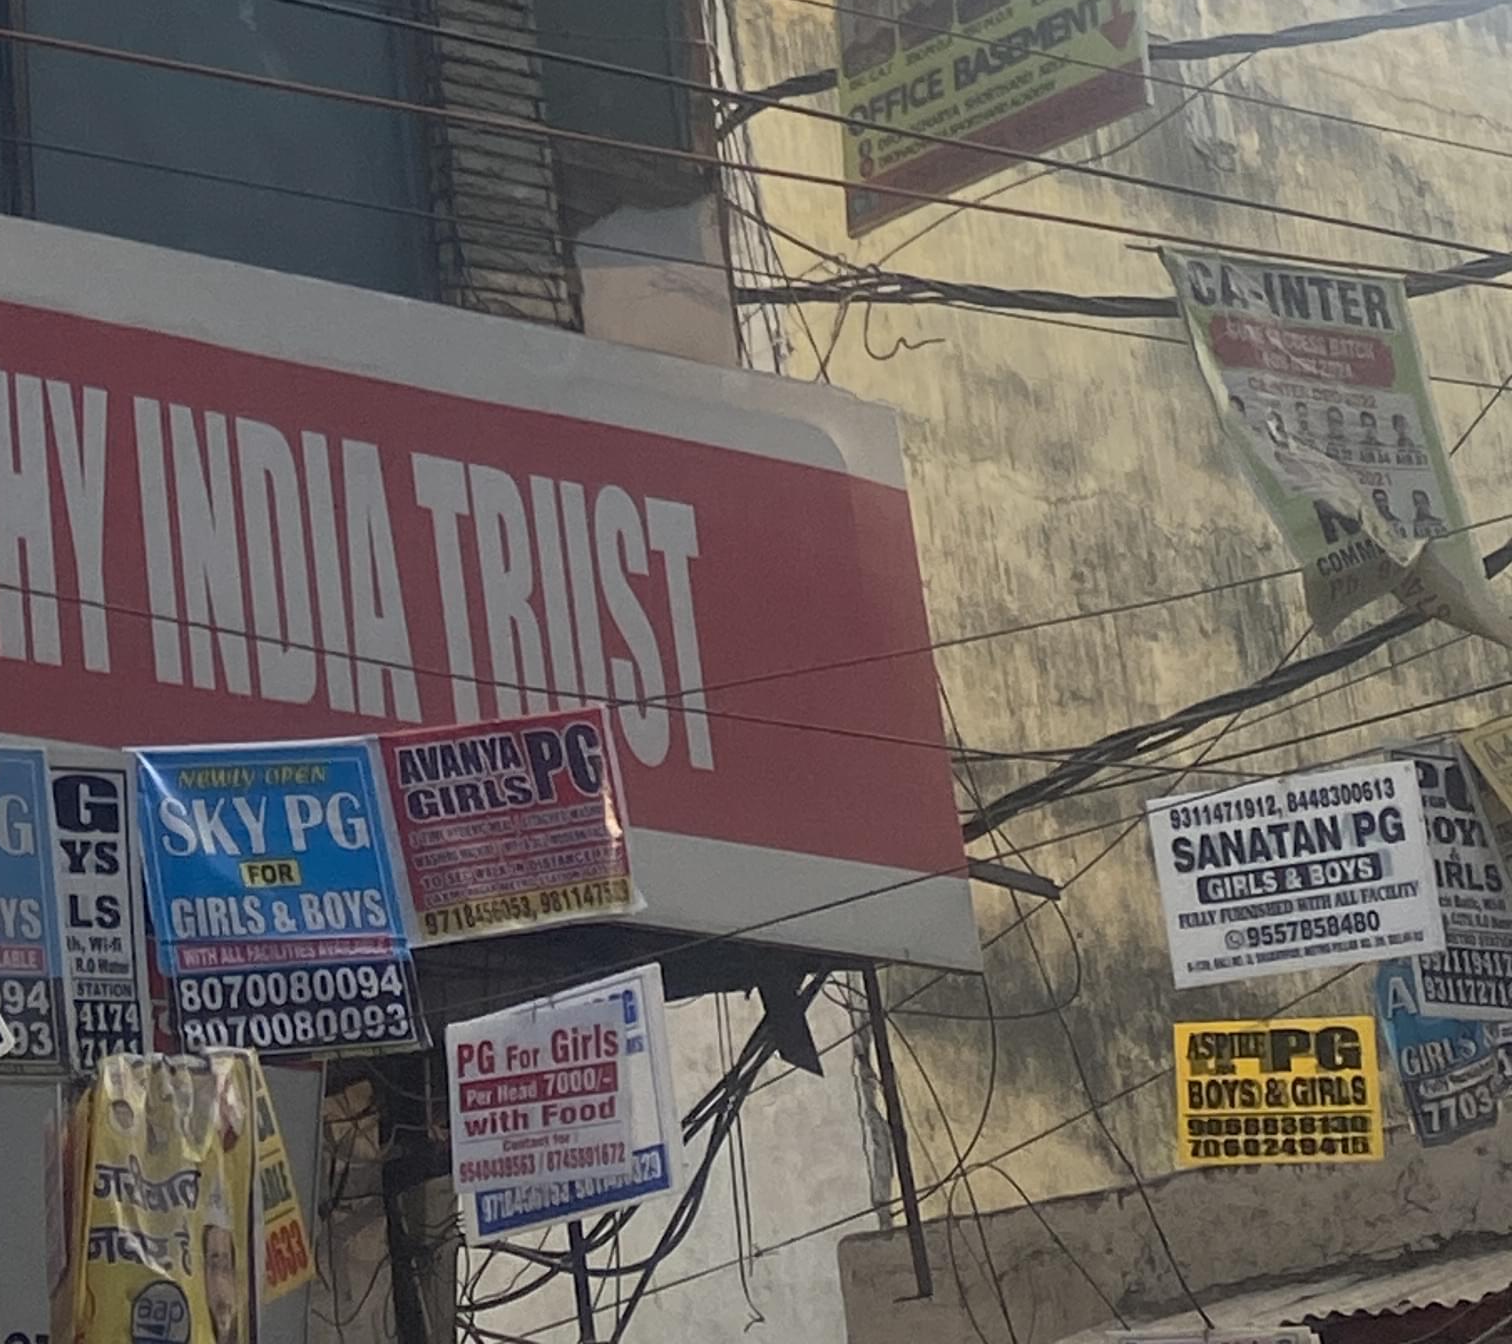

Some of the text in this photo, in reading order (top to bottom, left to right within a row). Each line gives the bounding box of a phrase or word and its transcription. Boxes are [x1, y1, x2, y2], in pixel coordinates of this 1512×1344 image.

[848, 67, 945, 138] OFFICE
[1187, 260, 1394, 331] CA-INTER
[133, 394, 422, 725] INDIA
[411, 452, 715, 774] TRUST
[397, 723, 605, 803] AVANYA PG
[405, 773, 534, 823] GIRLS
[1287, 776, 1396, 813] 8448300613
[158, 794, 268, 858] SKY
[283, 791, 372, 852] PG
[1171, 806, 1407, 874] SANATAN PG
[246, 863, 296, 886] FOR
[1206, 856, 1375, 901] GIRLS & BOYS
[1334, 888, 1358, 908] ALL
[1360, 879, 1420, 904] FACILITY
[171, 888, 388, 938] GIRLS & BOYS
[183, 945, 244, 968] WITH ALL
[180, 964, 404, 1012] 8070080094
[456, 1039, 496, 1079] PG
[506, 1044, 540, 1073] For
[550, 1023, 620, 1064] Girls
[1269, 1026, 1362, 1073] PG
[465, 1086, 494, 1107] Per
[496, 1079, 538, 1104] Head
[1187, 1075, 1369, 1110] BOYS & GIRLS
[464, 1096, 616, 1138] with Food
